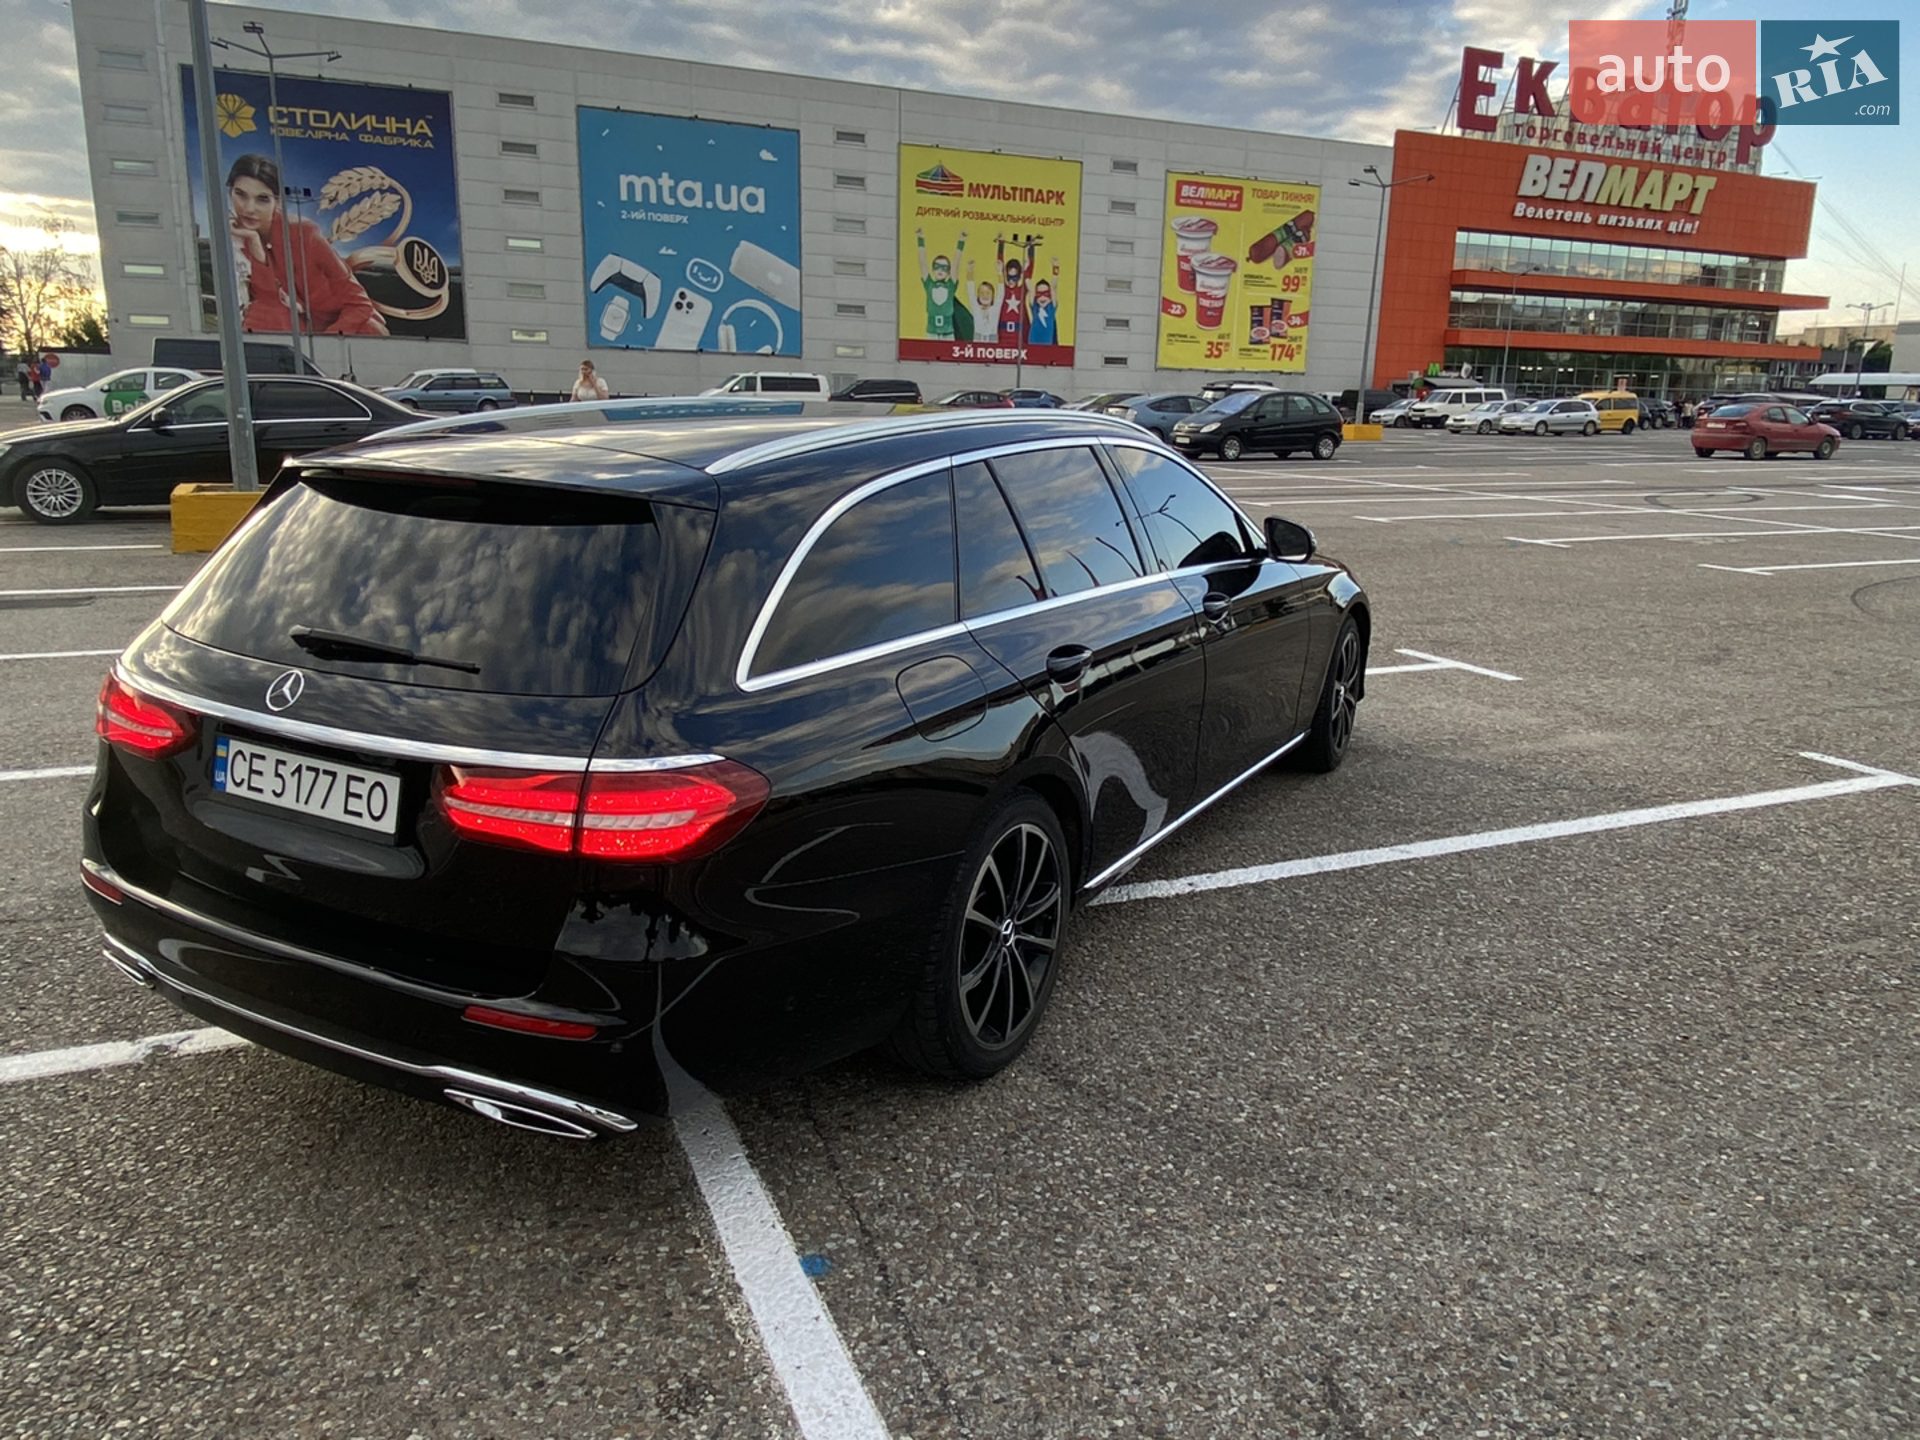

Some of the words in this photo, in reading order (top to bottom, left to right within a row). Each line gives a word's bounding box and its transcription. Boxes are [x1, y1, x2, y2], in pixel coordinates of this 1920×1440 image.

[268, 106, 433, 138] СТОЛИЧНА
[270, 126, 350, 142] ЮВЕЛІРНА
[358, 133, 435, 149] ФАБРИКА
[619, 172, 765, 214] mta.ua
[967, 182, 1066, 206] МУЛЬТІПАРК
[1181, 184, 1240, 201] ВЕЛМАРТ
[1251, 187, 1280, 200] ТОВАР
[1518, 154, 1718, 215] ВЕЛМАРТ
[620, 209, 646, 221] 2-ИЙ
[647, 212, 689, 225] ПОВЕРХ
[915, 206, 961, 218] ДИТЯЧИЙ
[962, 209, 1037, 225] РОЗВАЖАЛЬНИЙ
[1038, 217, 1065, 227] ЦЕНТР
[1513, 202, 1593, 225] Велетень
[1597, 212, 1663, 232] низьких
[1667, 218, 1700, 235] цін!
[952, 344, 974, 358] 3-Й
[976, 347, 1028, 360] ПОВЕРХ
[1270, 343, 1295, 362] 174
[215, 770, 226, 784] UA
[229, 749, 267, 794] CE
[271, 758, 338, 810] 5177
